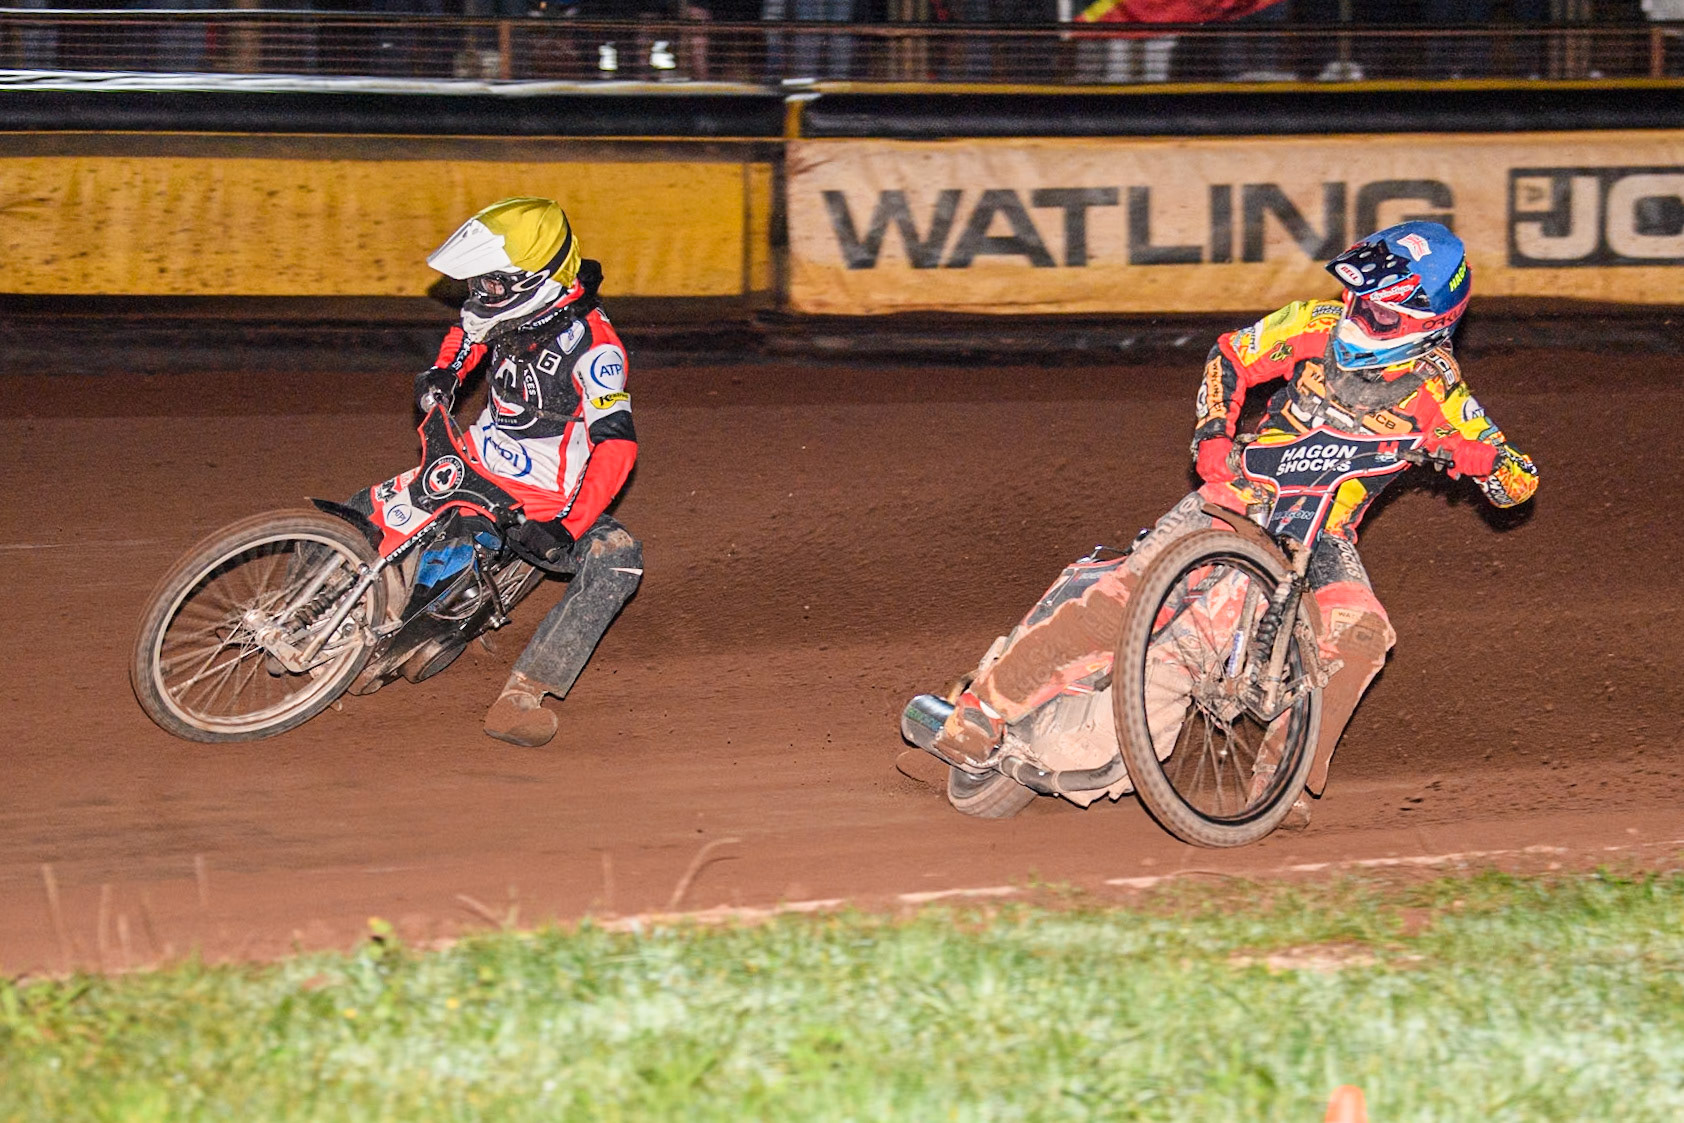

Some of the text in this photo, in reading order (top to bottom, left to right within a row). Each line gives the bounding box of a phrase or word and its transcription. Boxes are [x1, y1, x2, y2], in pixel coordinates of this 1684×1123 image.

[821, 179, 1454, 271] WATLING
[1340, 265, 1360, 282] BELL
[539, 352, 559, 371] 6
[599, 363, 623, 377] ATP
[1280, 443, 1359, 464] HAGON
[1275, 459, 1352, 477] SHOCKS
